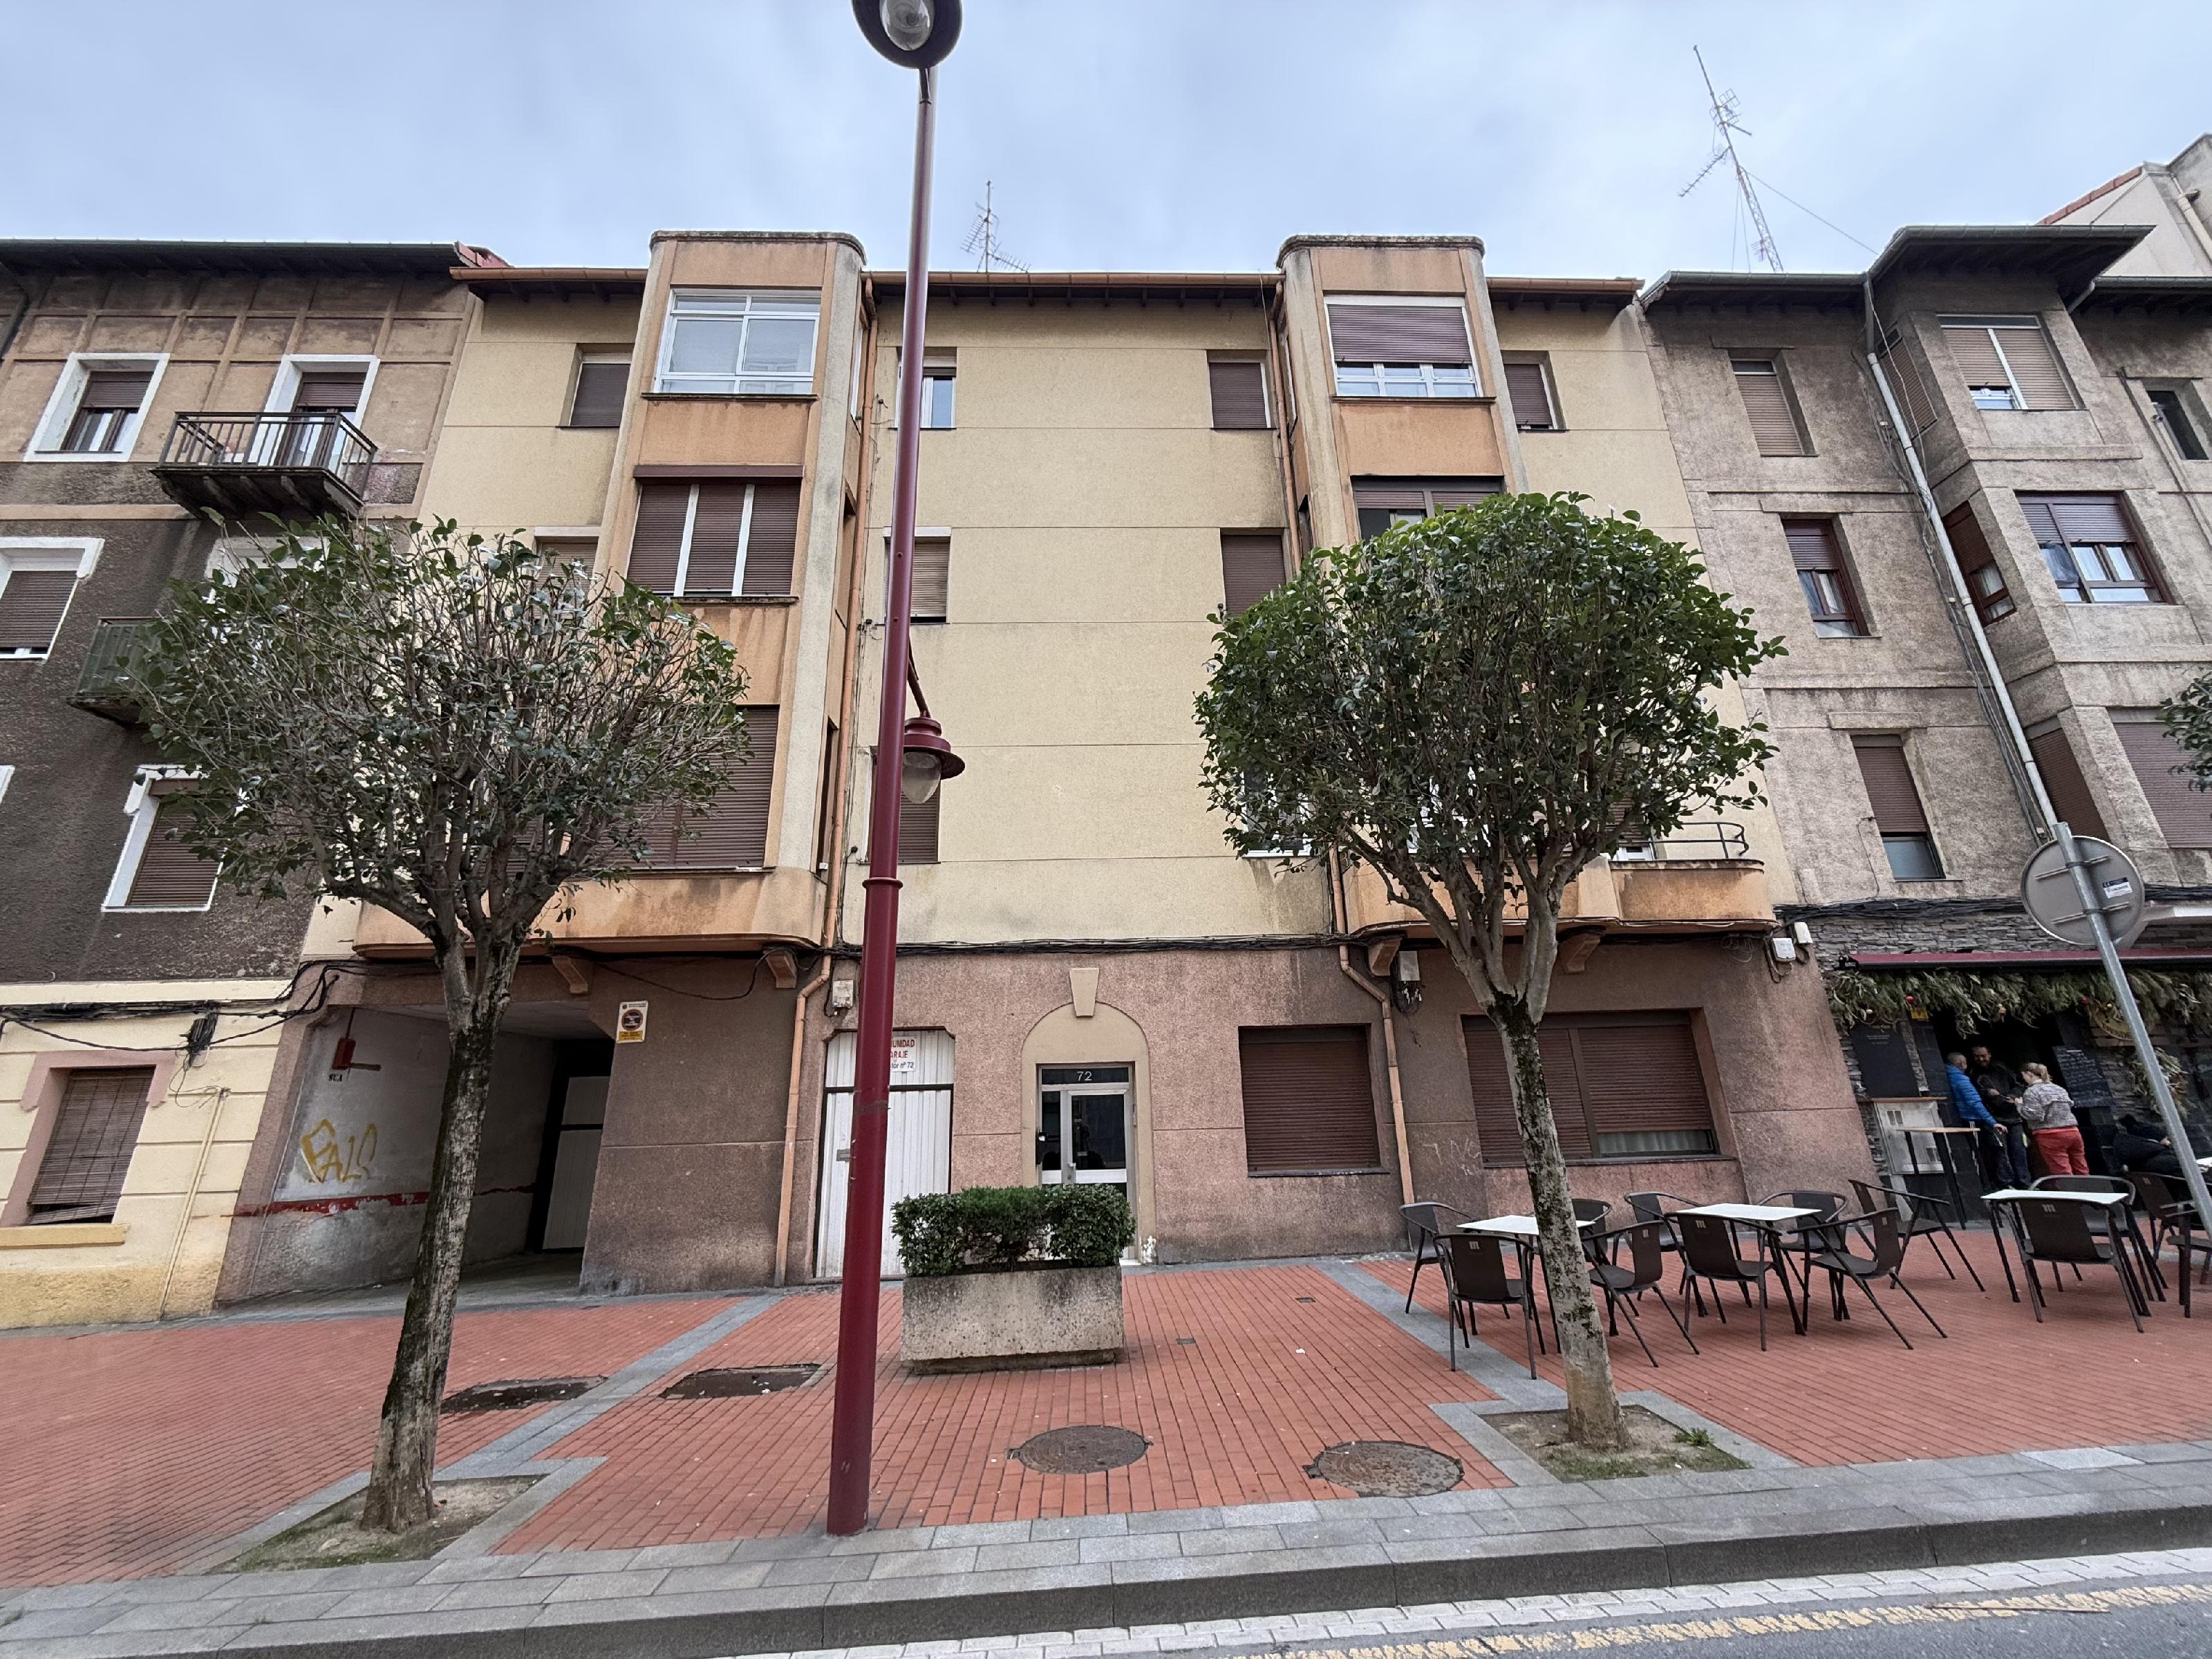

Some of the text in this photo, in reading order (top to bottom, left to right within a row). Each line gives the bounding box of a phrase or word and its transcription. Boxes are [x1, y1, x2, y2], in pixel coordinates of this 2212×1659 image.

[890, 1039, 915, 1048] UNIDAD
[890, 1050, 908, 1058] ARAJE
[1077, 1071, 1092, 1081] 72
